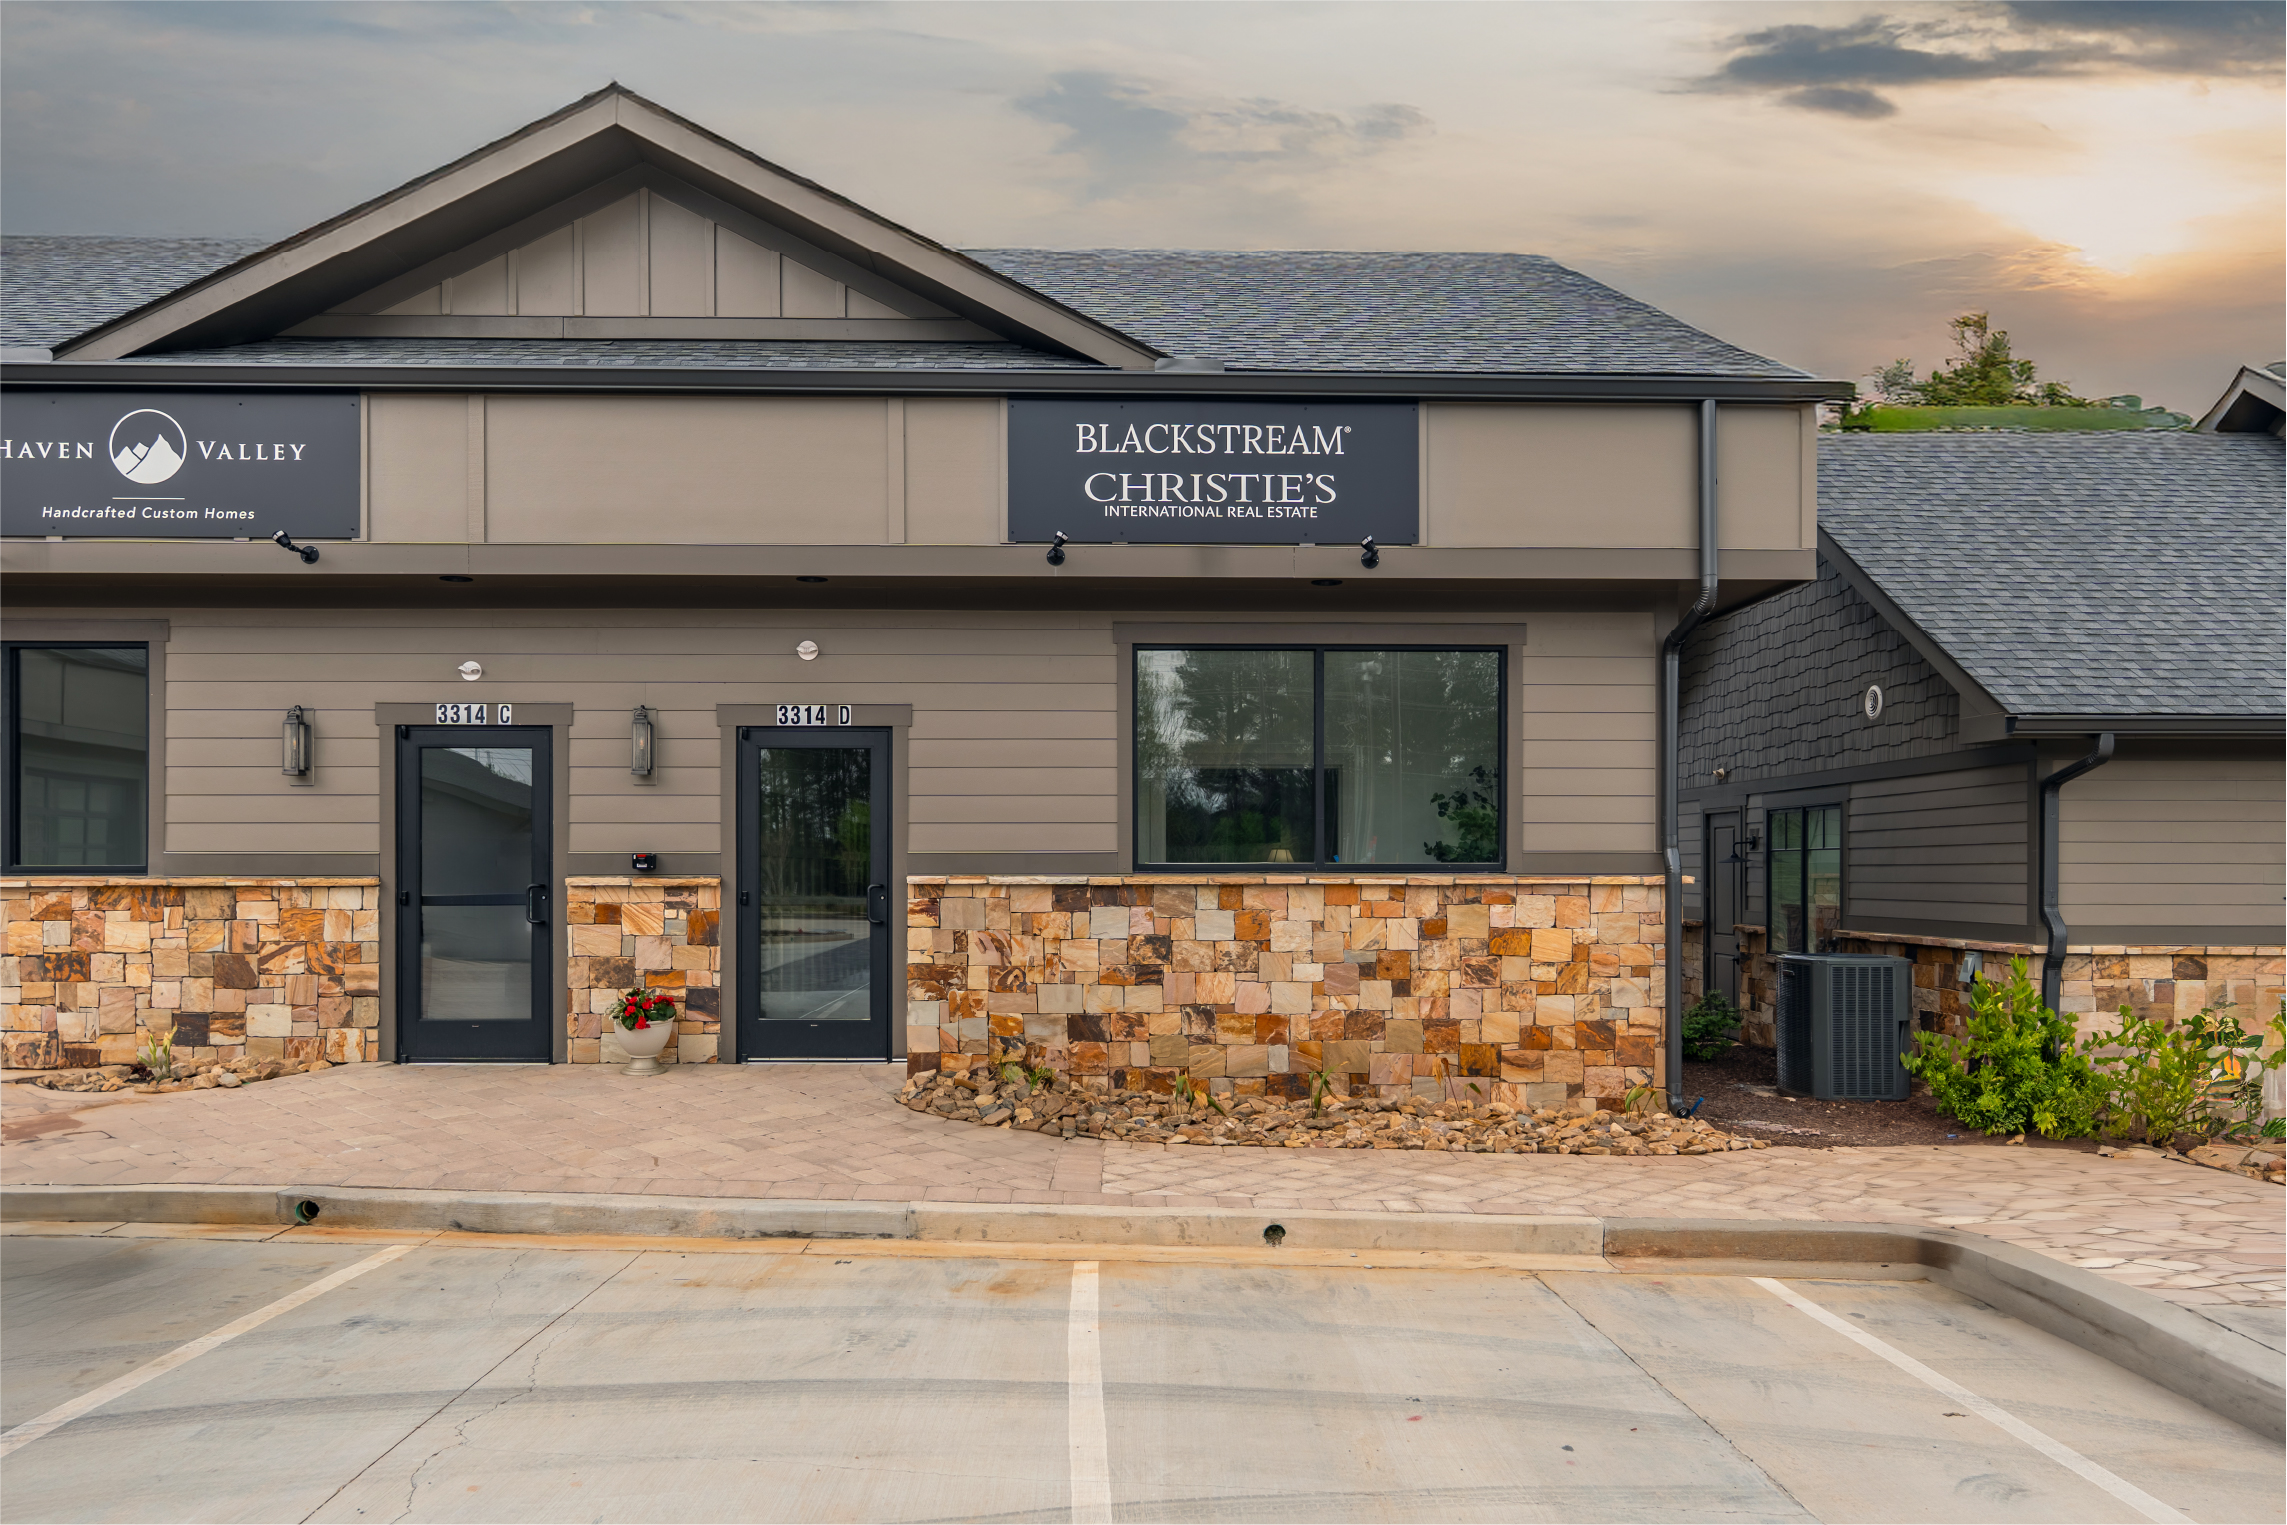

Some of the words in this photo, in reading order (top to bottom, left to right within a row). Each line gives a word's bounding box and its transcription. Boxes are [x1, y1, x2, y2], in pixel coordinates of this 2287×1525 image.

[0, 439, 94, 459] HAVEN
[196, 440, 307, 461] VALLEY
[1084, 472, 1337, 504] CHRISTIE'S
[41, 505, 137, 519] Handcrafted
[141, 506, 198, 519] Custom
[204, 507, 255, 520] Homes
[1104, 505, 1223, 518] INTERNATIONAL
[1227, 506, 1264, 518] REAL
[1267, 506, 1318, 518] ESTATE
[437, 704, 486, 724] 3314
[499, 705, 510, 724] C
[778, 705, 826, 725] 3314
[839, 705, 850, 725] D
